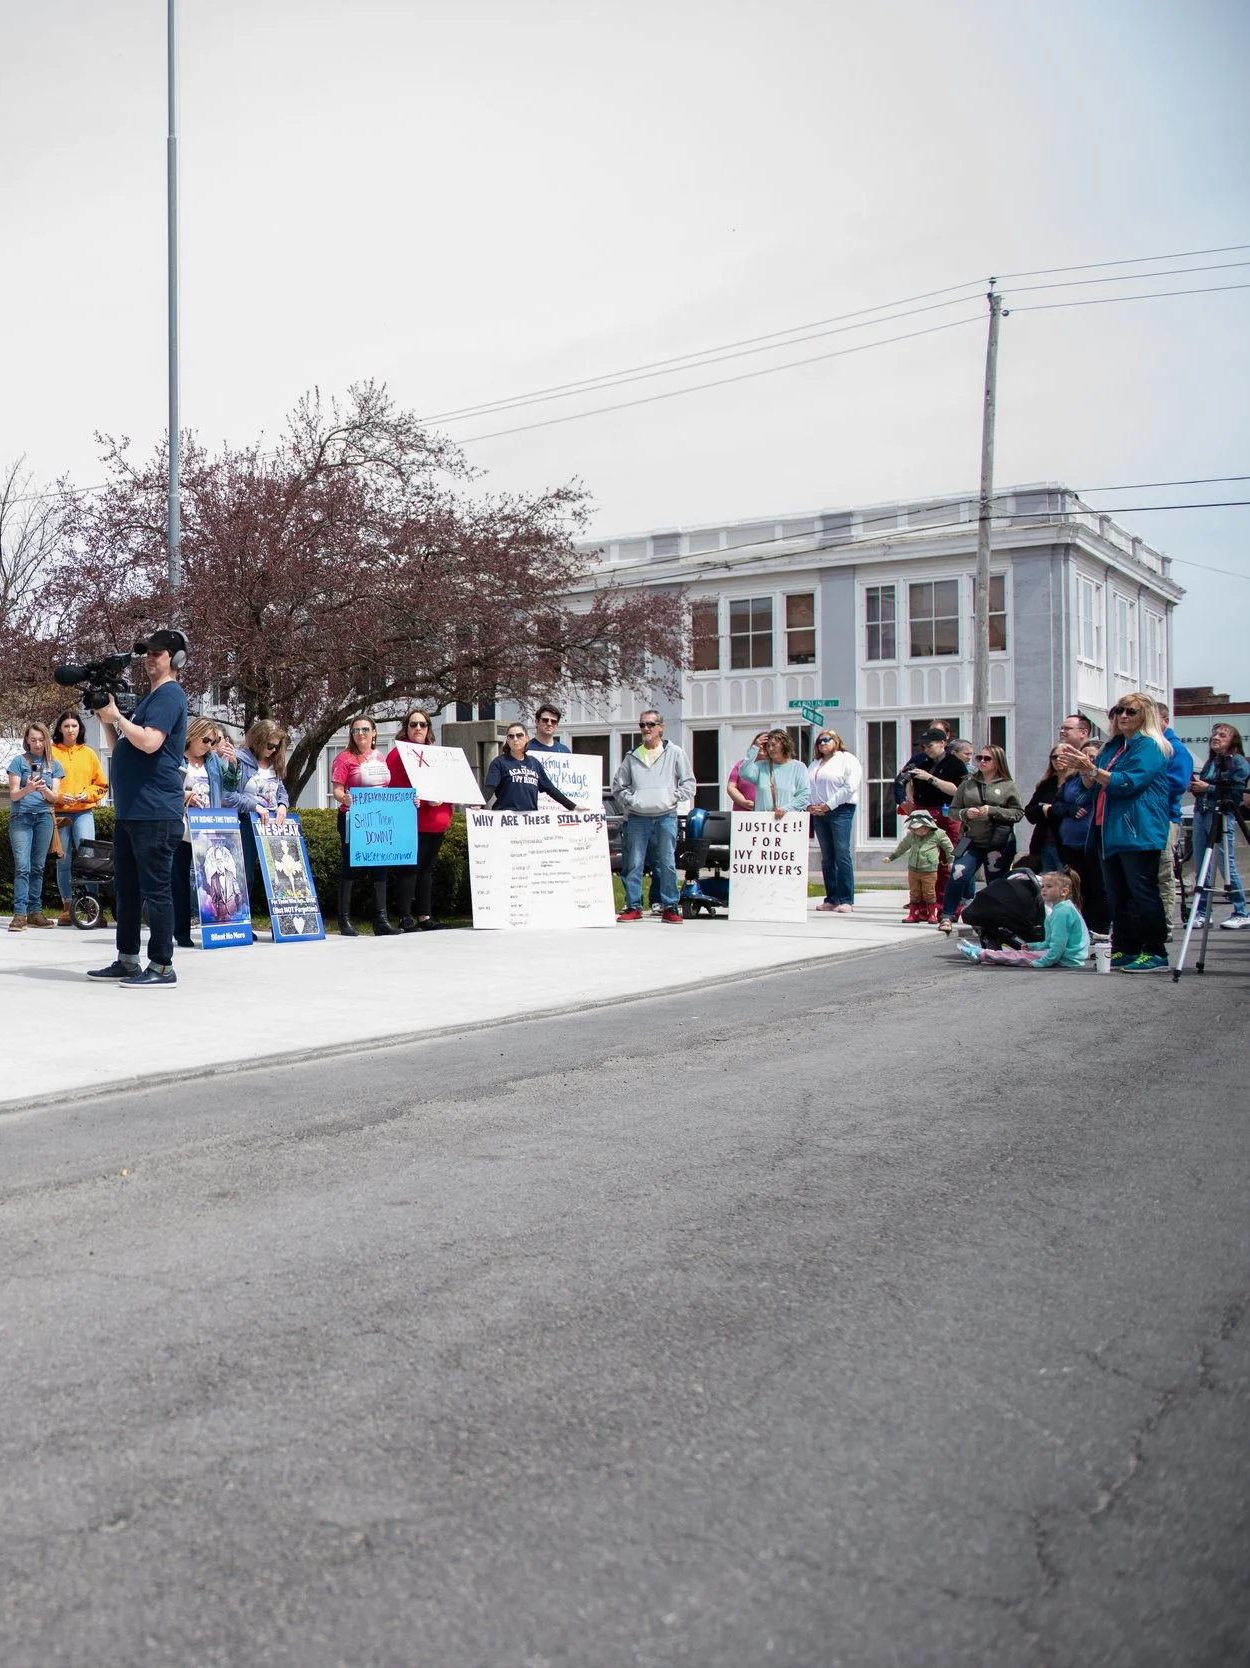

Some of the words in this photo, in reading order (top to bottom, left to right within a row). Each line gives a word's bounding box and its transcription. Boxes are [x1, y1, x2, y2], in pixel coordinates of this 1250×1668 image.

[563, 759, 570, 769] at
[509, 767, 539, 779] ACADEMY
[561, 772, 589, 790] Ridge
[190, 815, 199, 824] IVY
[472, 813, 494, 827] WHY
[501, 814, 519, 827] ARE
[522, 813, 551, 825] THESE
[557, 814, 582, 824] STILL
[583, 813, 607, 823] OPEN
[256, 824, 272, 836] WE
[273, 824, 301, 837] SPEAK
[595, 822, 603, 834] ?
[365, 829, 393, 846] DOWN!
[752, 836, 782, 847] FOR
[734, 850, 753, 860] IVY
[761, 850, 795, 861] RIDGE
[732, 863, 802, 876] SURVIVER'S
[283, 906, 294, 914] NOT
[211, 933, 226, 941] Silent
[226, 932, 232, 940] No
[232, 931, 246, 939] More
